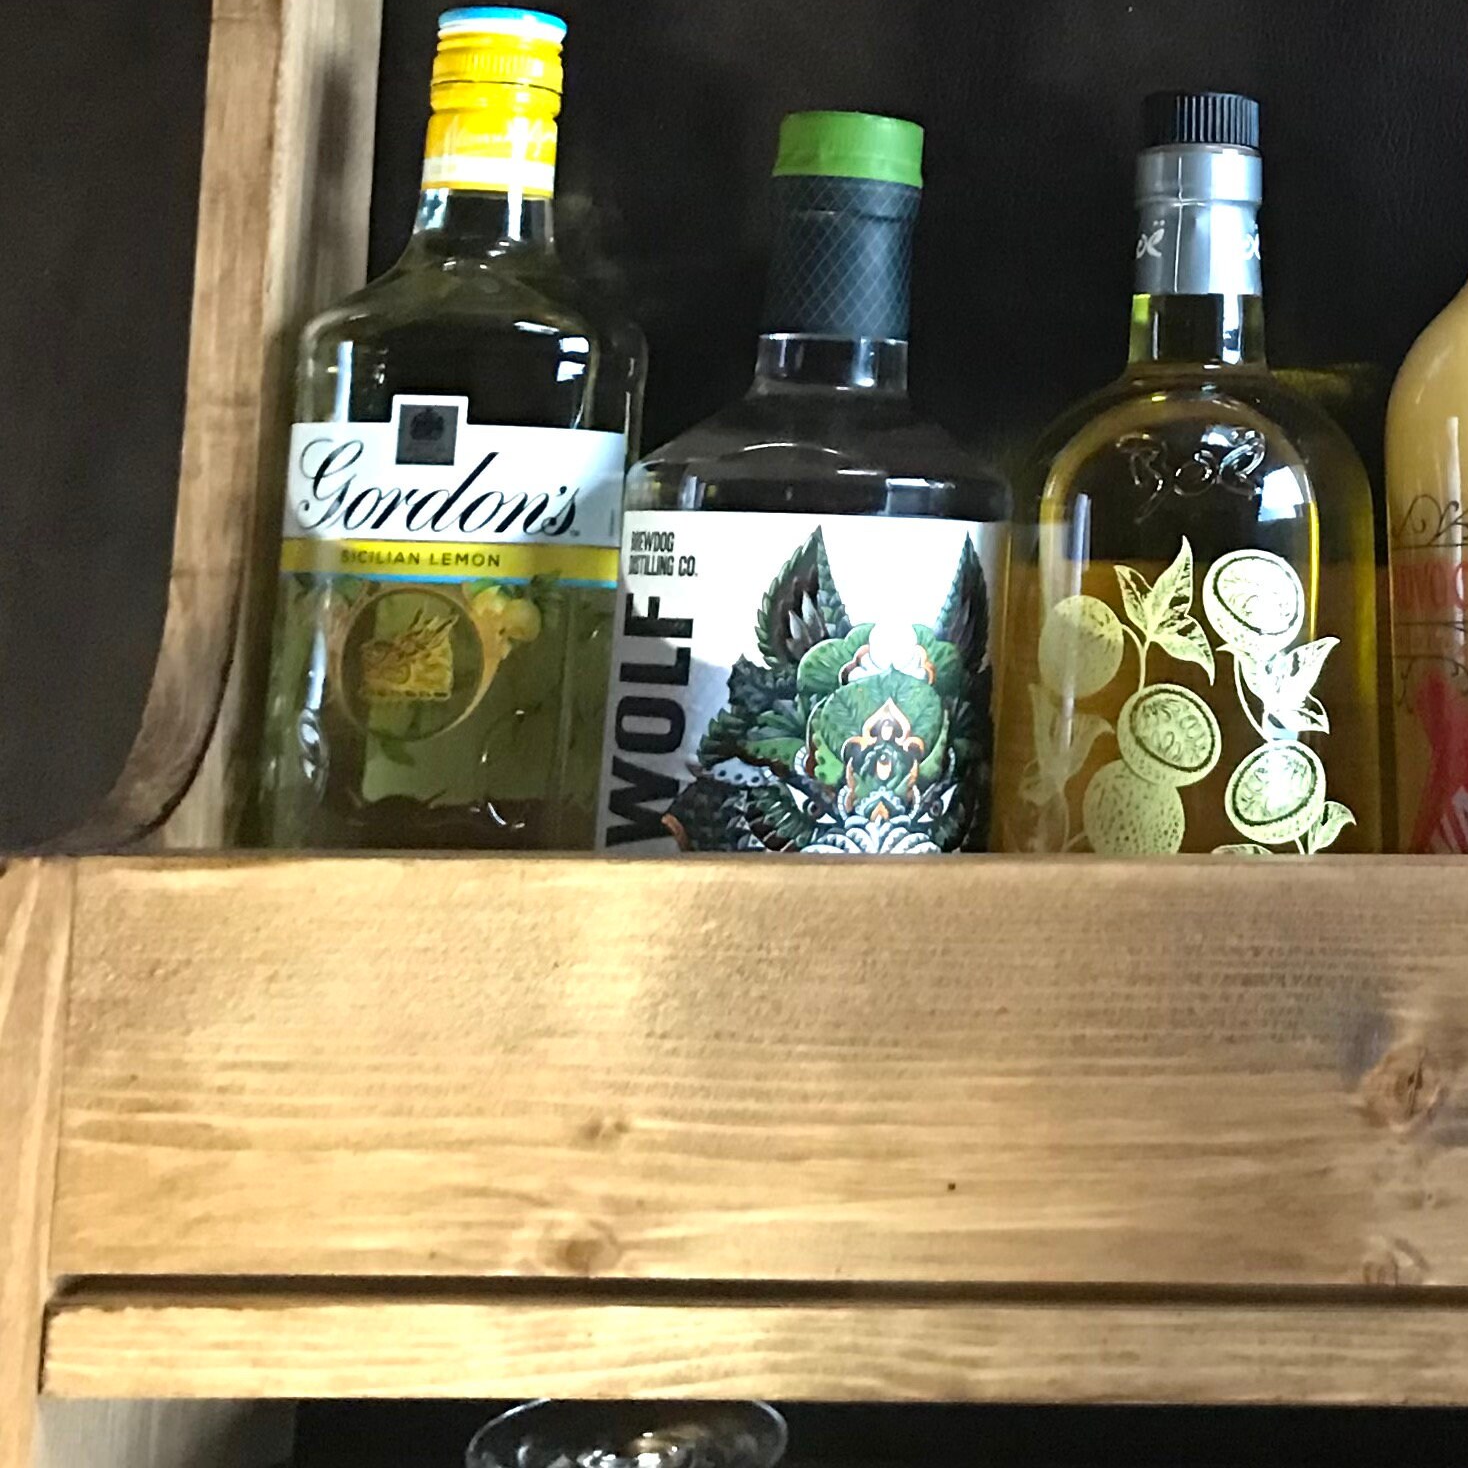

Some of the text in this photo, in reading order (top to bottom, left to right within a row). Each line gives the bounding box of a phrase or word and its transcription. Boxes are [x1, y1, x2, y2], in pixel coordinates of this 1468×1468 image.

[296, 438, 581, 537] Gordon's
[340, 549, 501, 568] SICILIAN LEMON
[606, 592, 695, 848] WOLF
